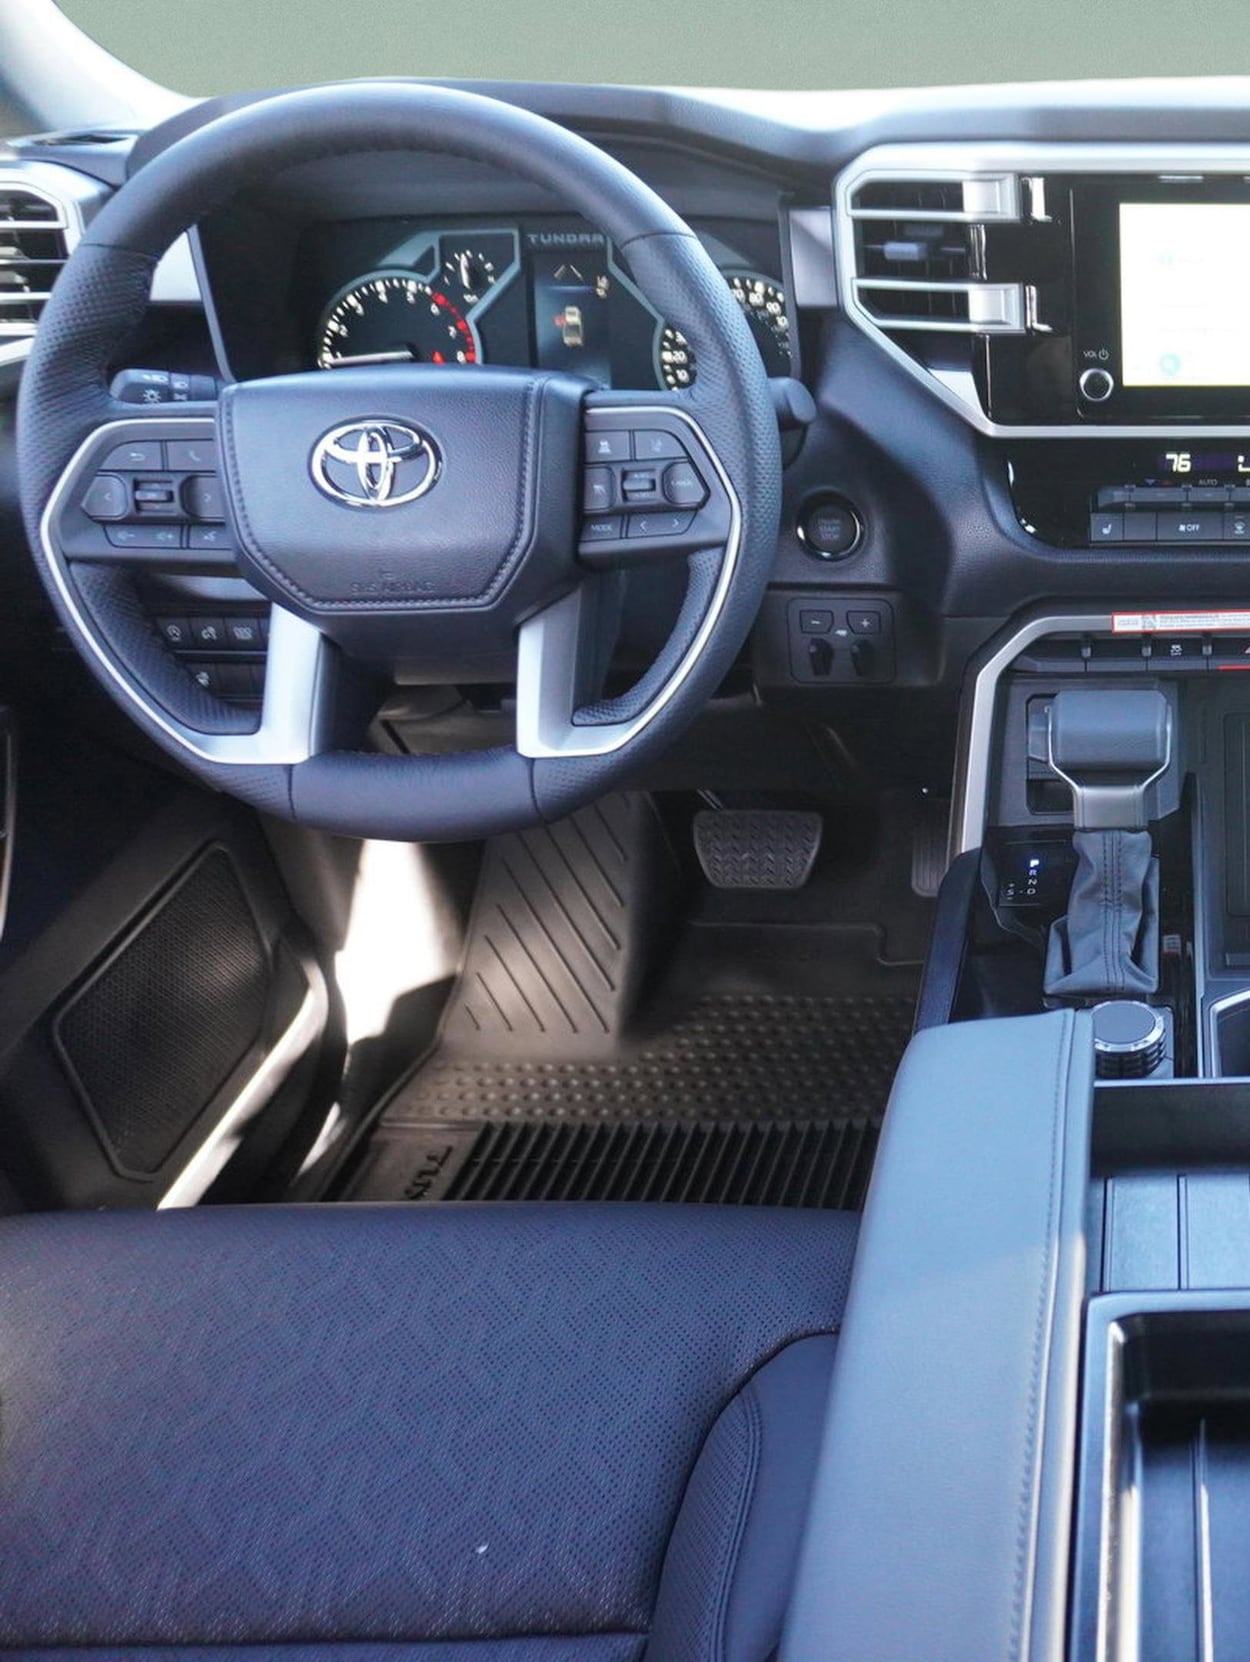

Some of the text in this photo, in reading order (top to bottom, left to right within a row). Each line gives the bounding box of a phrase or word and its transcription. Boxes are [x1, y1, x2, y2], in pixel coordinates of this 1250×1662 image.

[527, 233, 604, 245] TUNDRA
[430, 303, 440, 316] 6
[766, 301, 781, 315] 90
[448, 325, 457, 338] 7
[456, 350, 466, 363] 8
[672, 350, 688, 364] 20
[676, 369, 689, 382] 10
[1165, 453, 1191, 472] 76
[1198, 478, 1218, 487] AUTO
[591, 523, 613, 532] MODE
[1186, 523, 1201, 532] OFF
[1030, 859, 1040, 868] P
